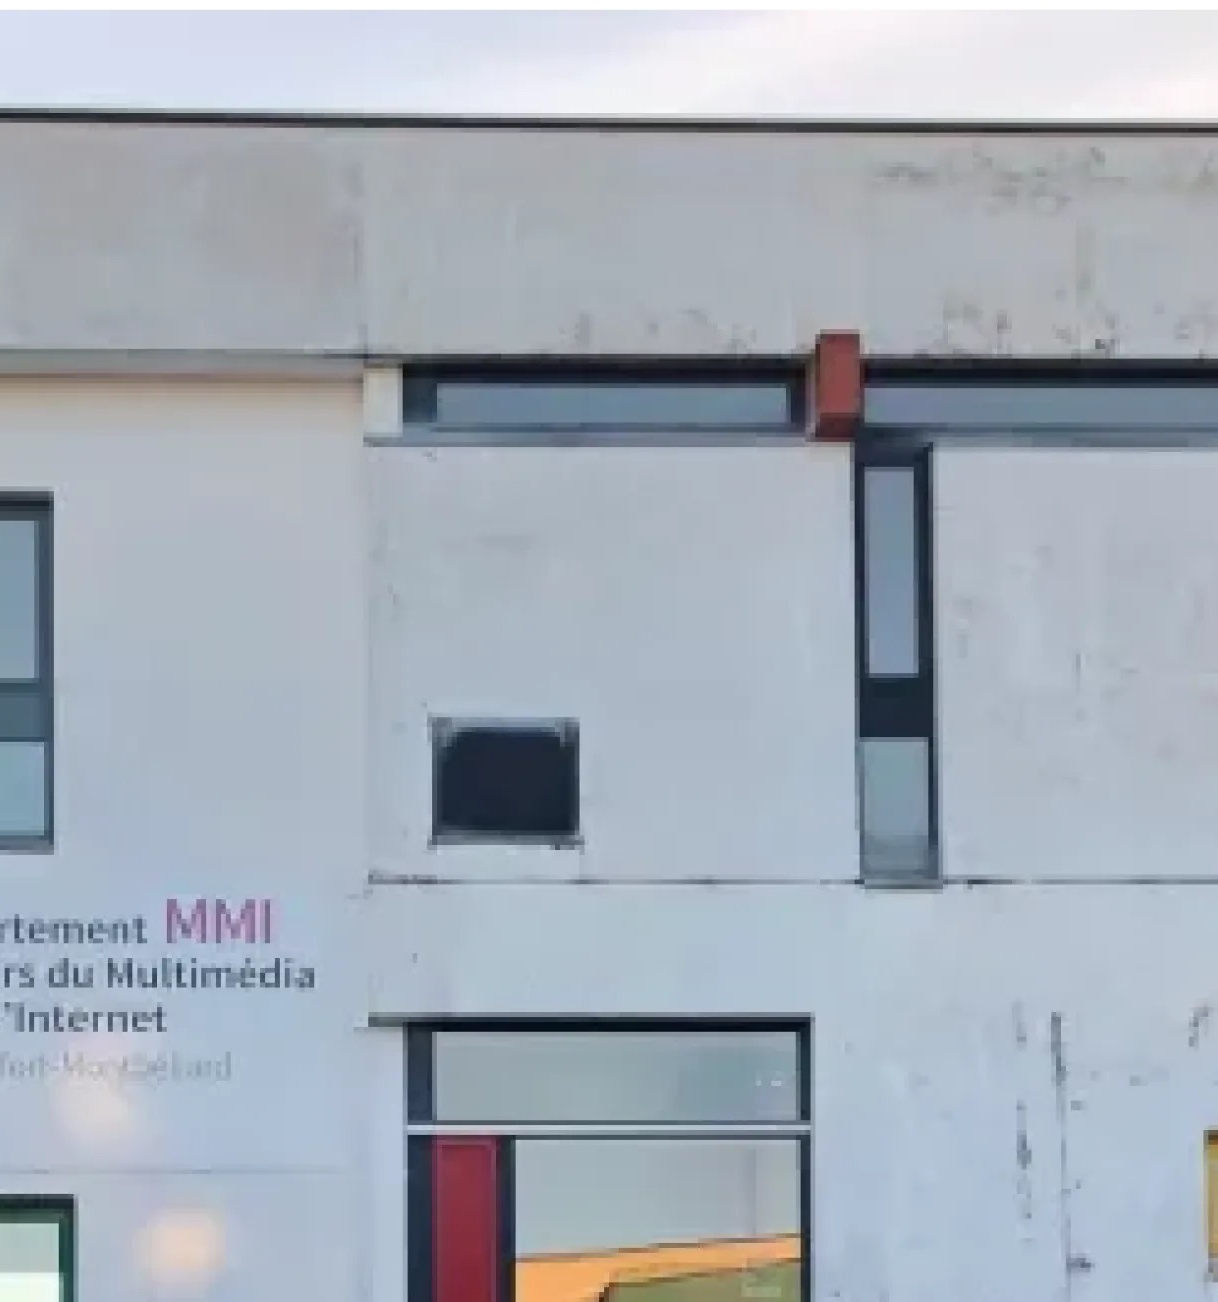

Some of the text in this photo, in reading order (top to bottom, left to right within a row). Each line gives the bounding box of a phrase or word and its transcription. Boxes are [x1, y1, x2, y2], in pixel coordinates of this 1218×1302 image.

[167, 899, 270, 943] MMI
[49, 957, 93, 988] du
[107, 956, 315, 988] Multimédia
